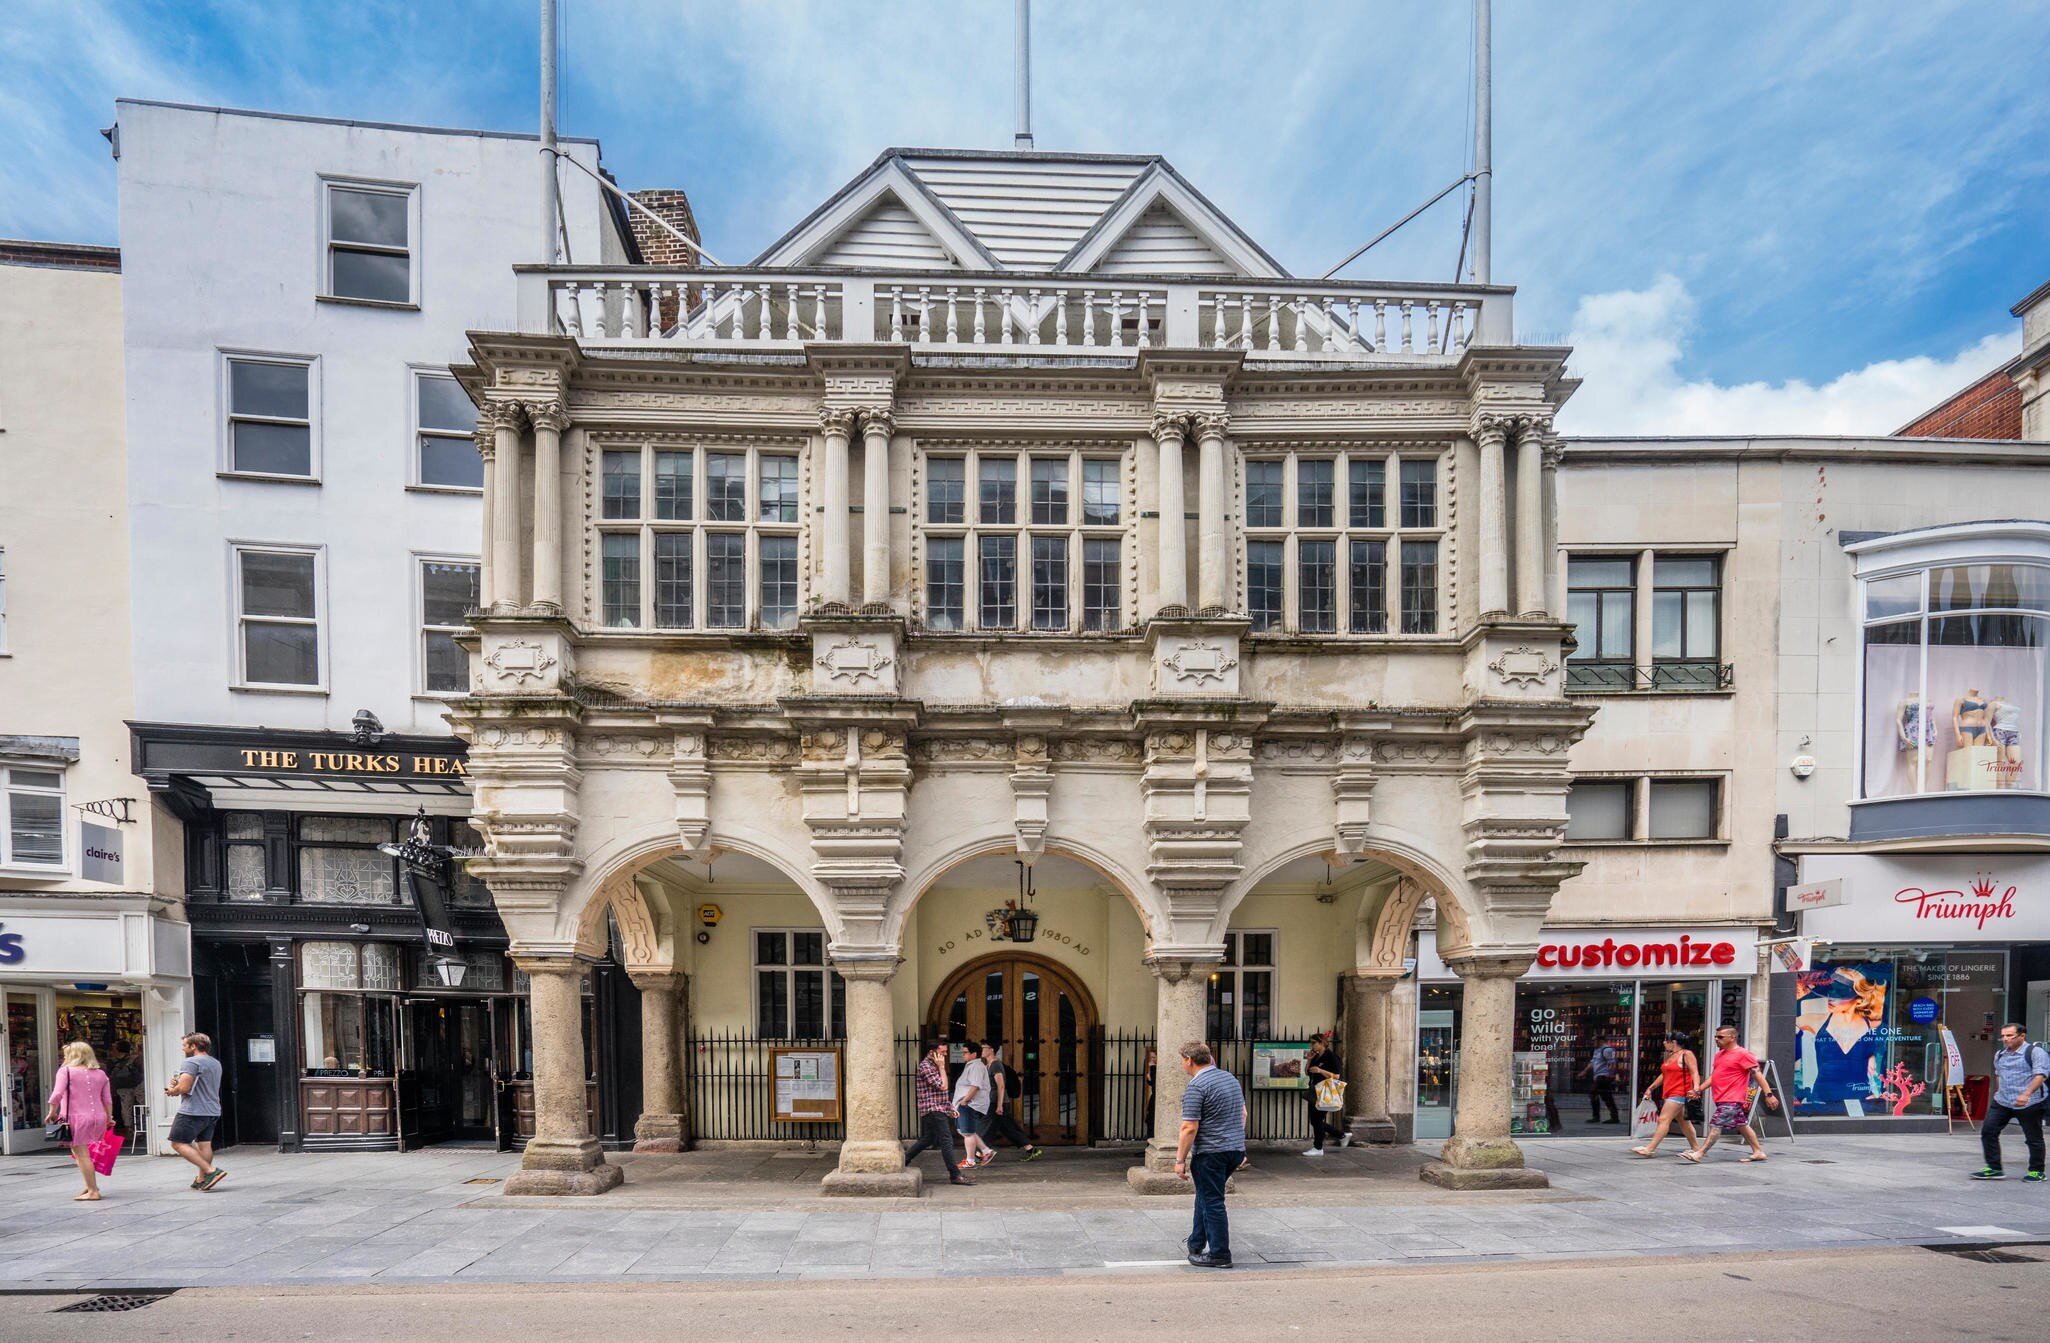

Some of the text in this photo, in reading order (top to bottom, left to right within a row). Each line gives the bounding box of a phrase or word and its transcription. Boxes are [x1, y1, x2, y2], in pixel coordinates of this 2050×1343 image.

[241, 750, 467, 775] THE TURKS HEA
[1977, 759, 2024, 776] Triumph
[86, 846, 120, 862] claire's
[1895, 887, 2017, 930] Triumph
[426, 928, 454, 947] PREZZO
[966, 929, 982, 941] AD
[1041, 929, 1089, 955] 1980 AD
[1537, 935, 1736, 968] customize
[1920, 964, 1946, 972] MAKER
[1948, 964, 1959, 972] OF
[1961, 964, 1997, 972] LINGERIE
[1928, 973, 1970, 981] SINCE 1886
[1530, 1008, 1555, 1022] go
[1530, 1021, 1565, 1033] wild
[1881, 1027, 1902, 1035] ONE
[1530, 1034, 1578, 1043] with your
[1530, 1043, 1556, 1051] fone!
